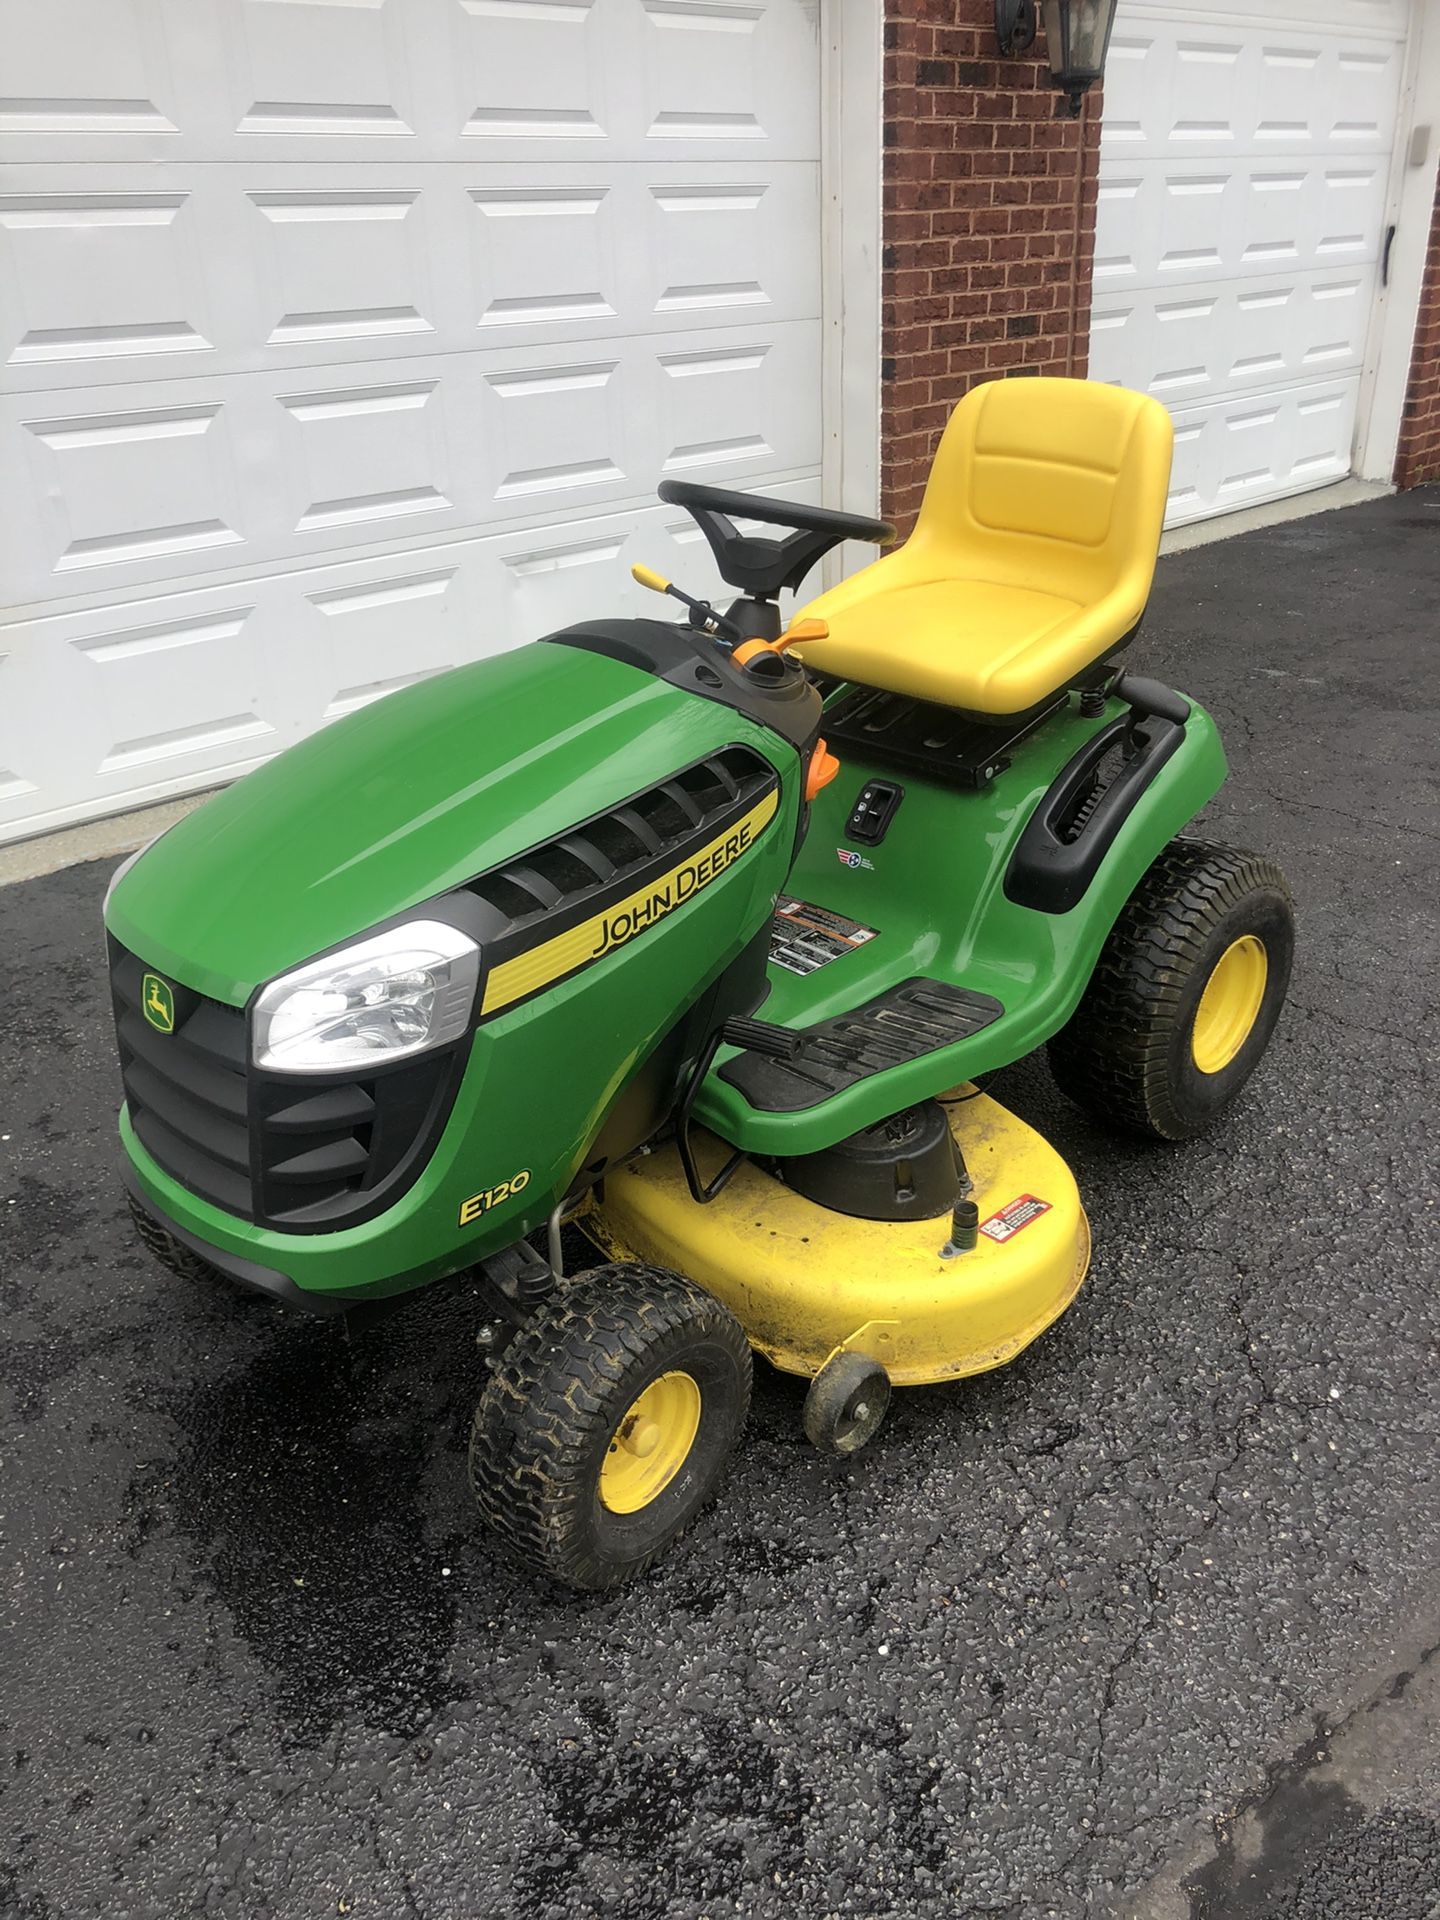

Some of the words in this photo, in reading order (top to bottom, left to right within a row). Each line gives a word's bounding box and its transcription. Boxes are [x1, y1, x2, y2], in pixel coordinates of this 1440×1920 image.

[592, 885, 671, 956] JOHN
[675, 820, 752, 900] DEERE
[458, 1170, 531, 1228] E120
